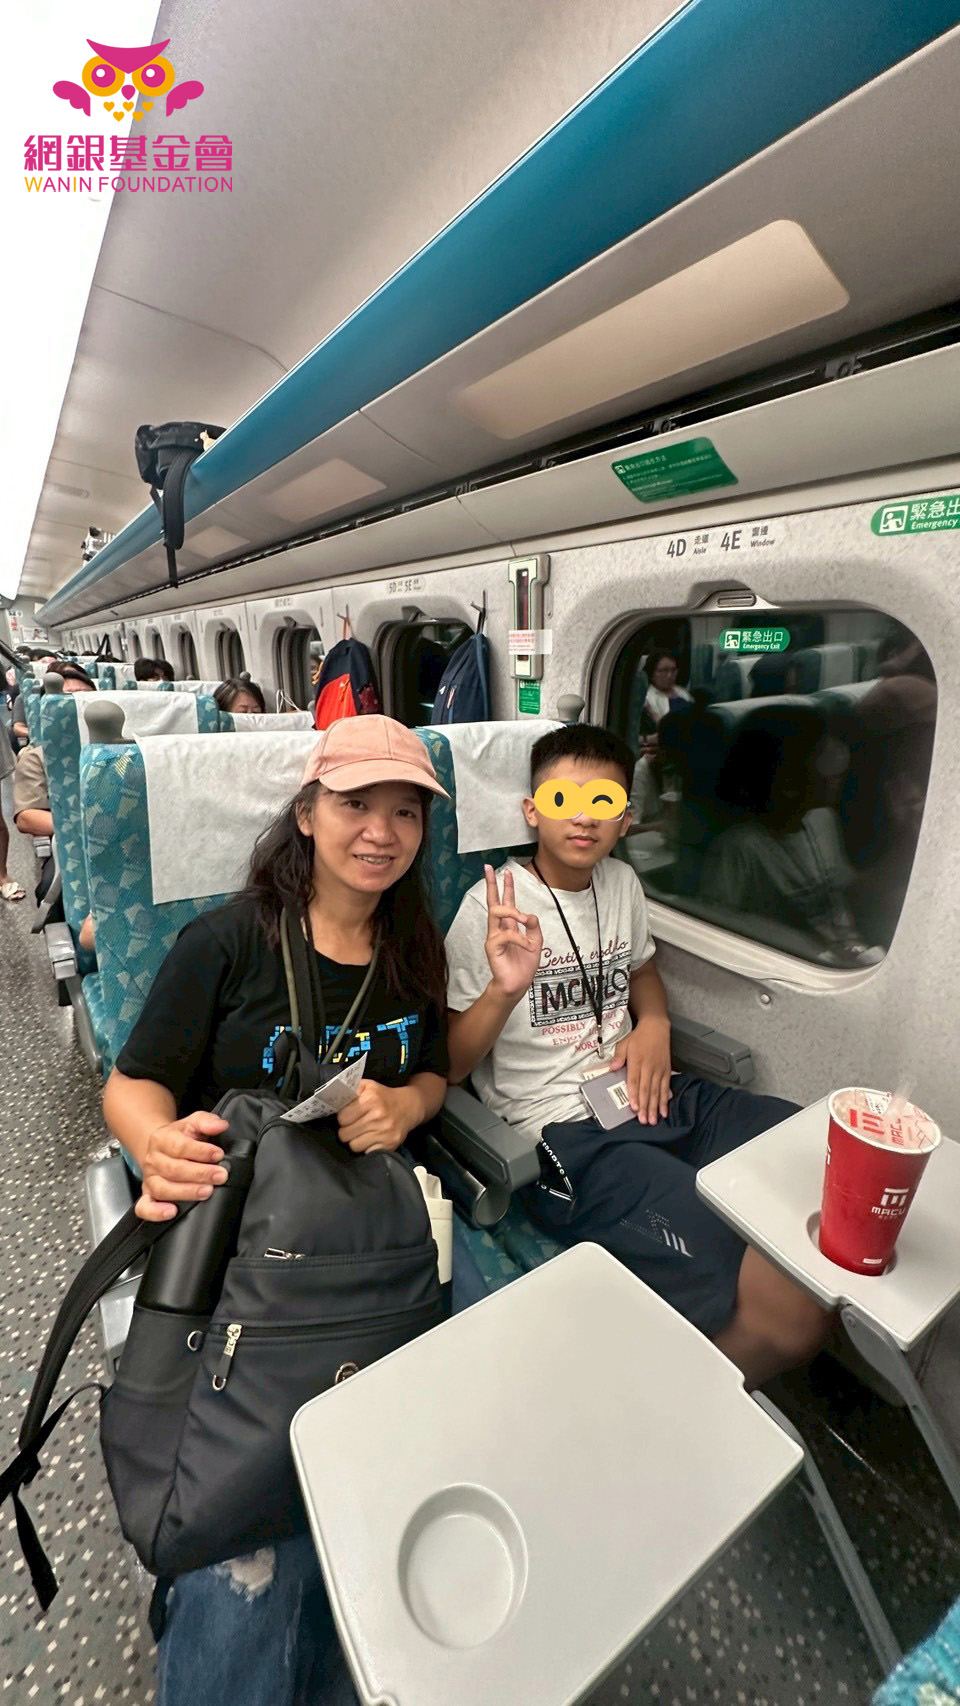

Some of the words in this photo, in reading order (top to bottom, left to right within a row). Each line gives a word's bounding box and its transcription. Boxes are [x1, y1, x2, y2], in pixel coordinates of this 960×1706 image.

[911, 519, 958, 531] Emergency
[667, 539, 687, 558] 4D
[720, 530, 742, 551] 4E
[693, 547, 706, 555] Aisle
[750, 538, 776, 548] Window
[742, 630, 783, 643] 緊急出口
[743, 643, 769, 651] Emergency
[542, 1022, 586, 1036] POSSIBLY
[575, 1040, 598, 1052] MORE
[871, 1206, 906, 1216] MACU
